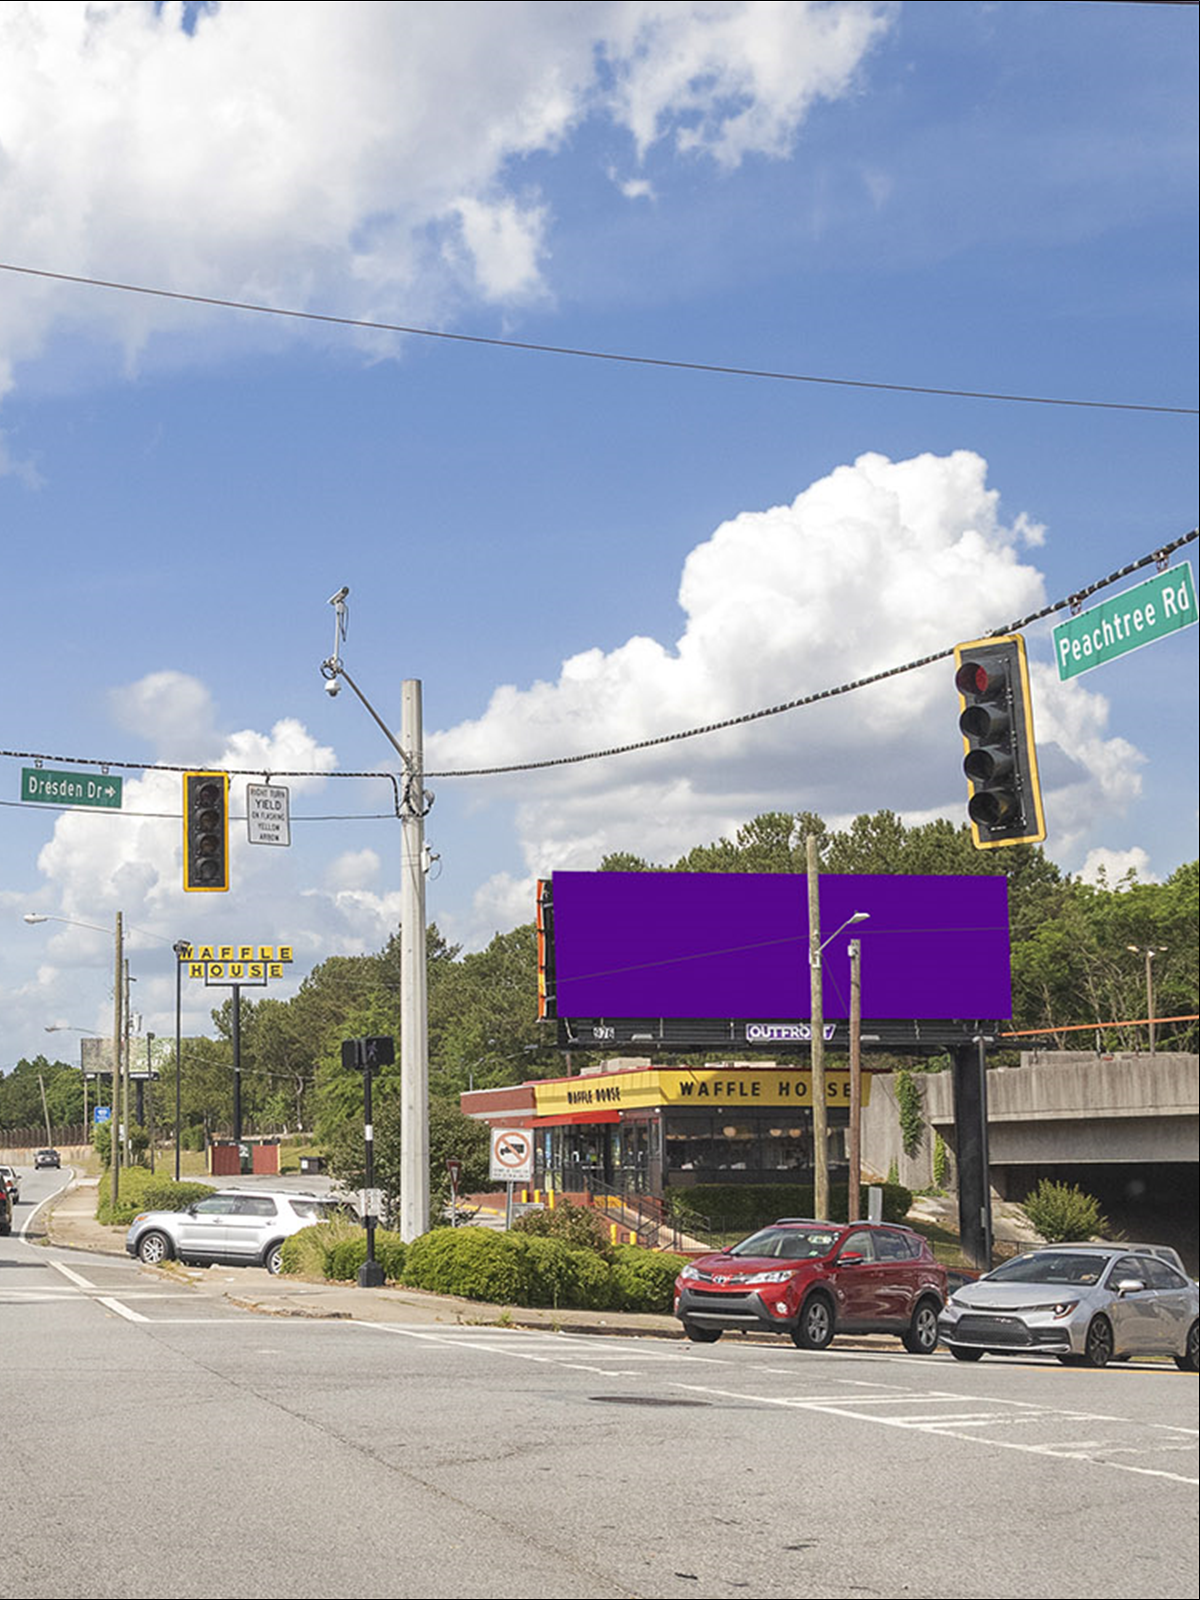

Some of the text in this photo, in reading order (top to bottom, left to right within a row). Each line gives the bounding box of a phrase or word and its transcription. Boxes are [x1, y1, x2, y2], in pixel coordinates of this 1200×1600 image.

[1059, 580, 1190, 667] Peachtree Rd
[28, 776, 102, 799] Dresden Dr
[255, 799, 282, 811] YIELD
[181, 947, 290, 959] WAFFLE
[191, 964, 281, 977] HOUSE
[749, 1025, 830, 1038] OUTFROT
[679, 1081, 851, 1097] WAFFLE HOSE
